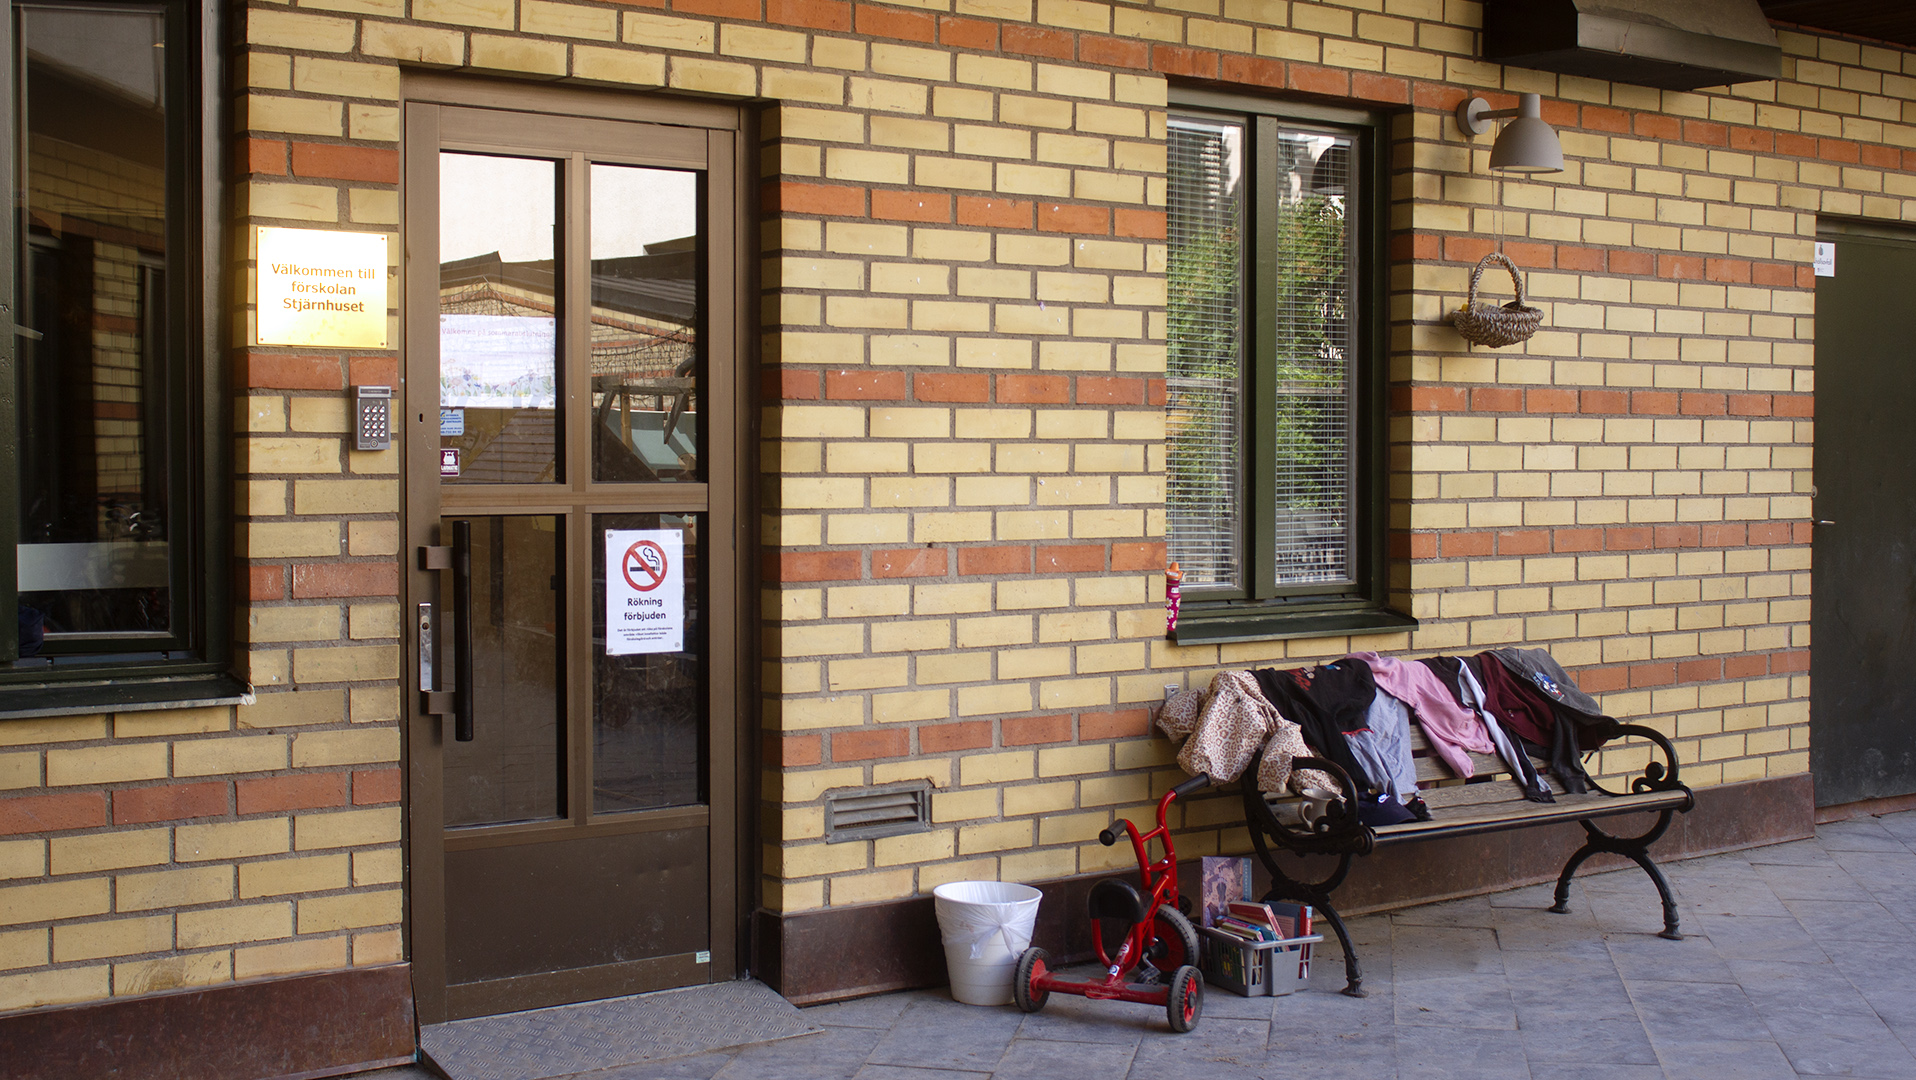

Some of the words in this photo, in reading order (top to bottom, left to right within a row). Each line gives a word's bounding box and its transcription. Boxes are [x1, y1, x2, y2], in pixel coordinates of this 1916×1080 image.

[271, 263, 353, 278] Välkommen
[358, 268, 375, 279] till
[291, 280, 356, 295] förskolan
[283, 297, 365, 312] Stjärnhuset
[627, 597, 663, 607] Rökning
[624, 611, 666, 621] förbjuden
